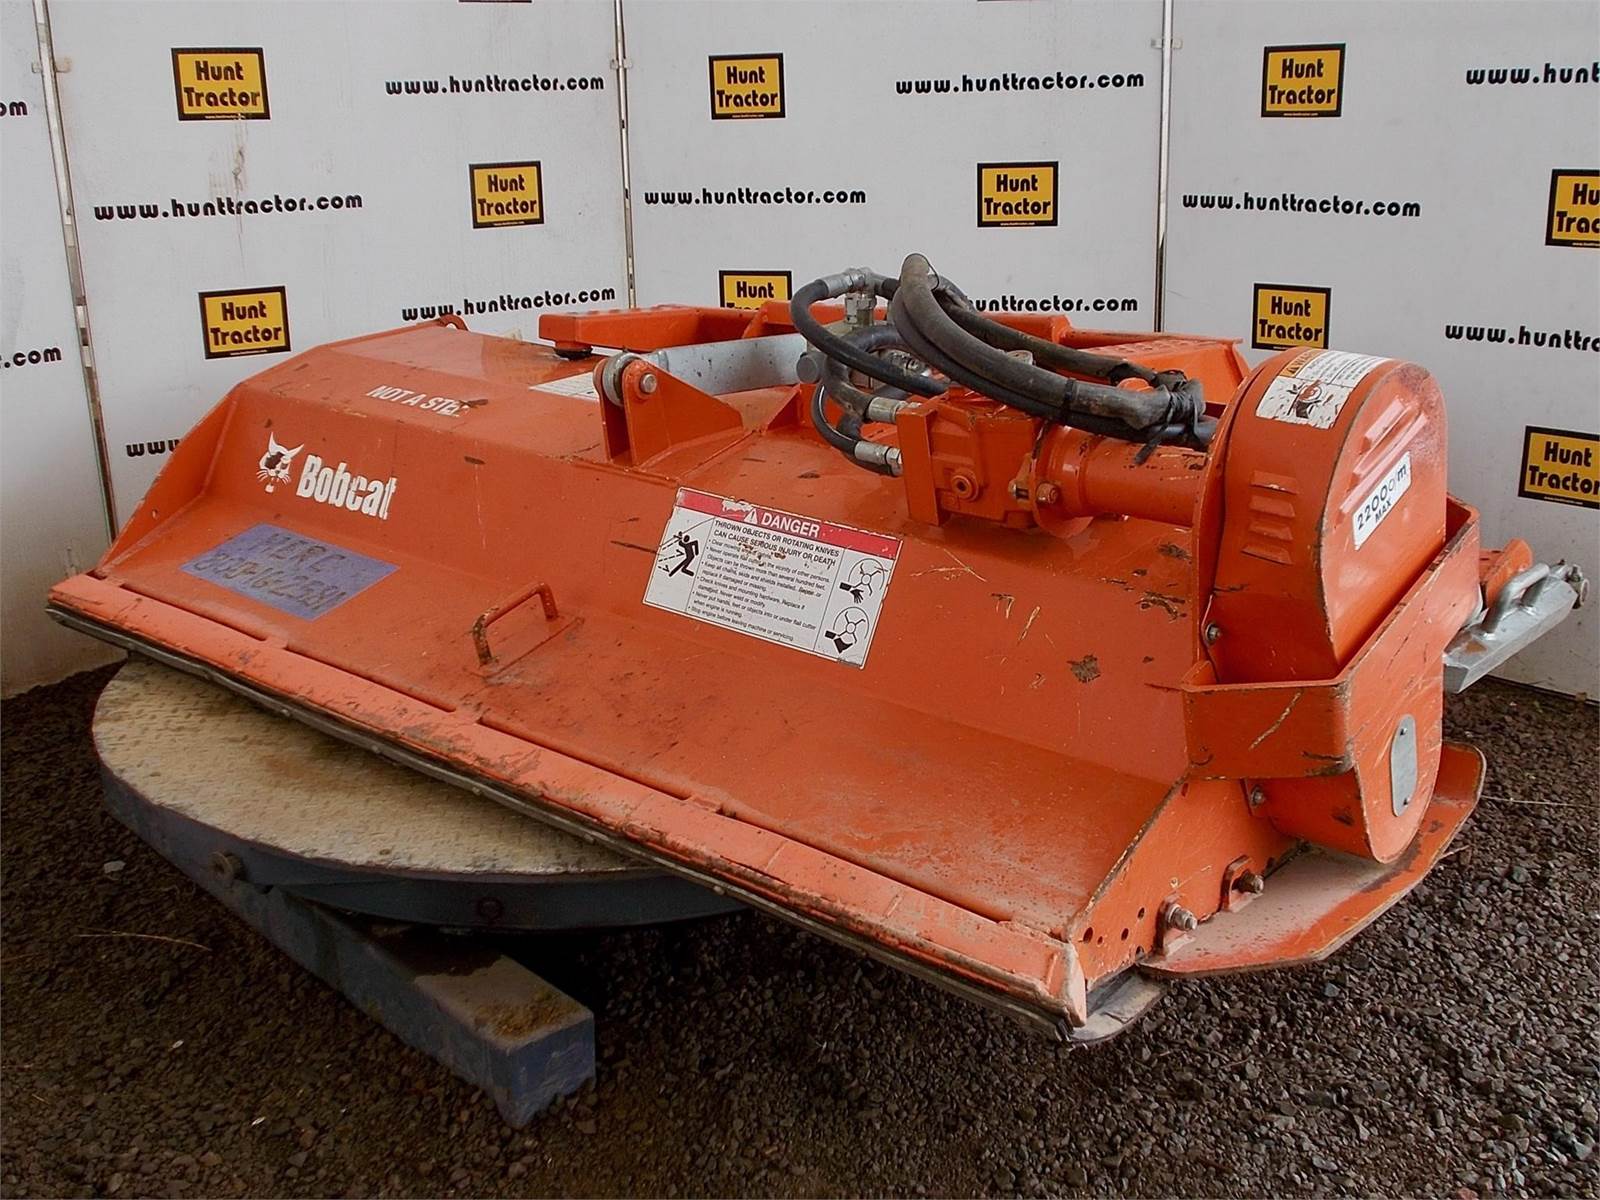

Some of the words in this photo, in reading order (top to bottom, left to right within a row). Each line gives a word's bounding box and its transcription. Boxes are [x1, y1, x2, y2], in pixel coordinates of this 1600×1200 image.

[194, 60, 244, 81] Hunt
[726, 65, 766, 85] Hunt
[1281, 57, 1324, 79] Hunt
[385, 74, 604, 95] www.hunttractor.com
[895, 71, 1144, 95] www.hunttractor.com
[1265, 82, 1336, 105] Tractor
[180, 83, 264, 111] Tractor
[713, 86, 779, 111] Tractor
[487, 173, 526, 193] Hunt
[996, 173, 1039, 193] Hunt
[93, 194, 363, 221] www.hunttractor.com
[475, 195, 541, 220] Tractor
[644, 187, 866, 205] www.hunttractor.com
[983, 197, 1052, 216] Tractor
[1182, 191, 1421, 217] www.hunttractor.com
[736, 280, 775, 299] Hunt
[220, 300, 267, 322] Hunt
[402, 287, 617, 322] www.hunttractor.com
[974, 295, 1139, 312] unttractor.com
[1270, 295, 1312, 318] Hunt
[207, 325, 285, 349] Tractor
[1255, 317, 1323, 343] Tractor
[3, 347, 62, 369] .com
[365, 384, 415, 402] NOT
[401, 393, 427, 406] A
[1543, 440, 1593, 468] Hunt
[295, 454, 397, 520] Bobcat
[1526, 463, 1600, 497] Tractor
[760, 511, 821, 538] DANGER
[713, 519, 742, 532] THROWN
[741, 526, 771, 540] OBJECTS
[770, 534, 782, 542] OR
[781, 536, 815, 551] ROTATING
[814, 544, 840, 557] KNIVES
[713, 529, 727, 538] CAN
[727, 532, 749, 544] CAUSE
[749, 538, 777, 551] SERIOUS
[777, 545, 802, 557] INJURY
[801, 551, 813, 560] OR
[812, 554, 836, 566] DEATH
